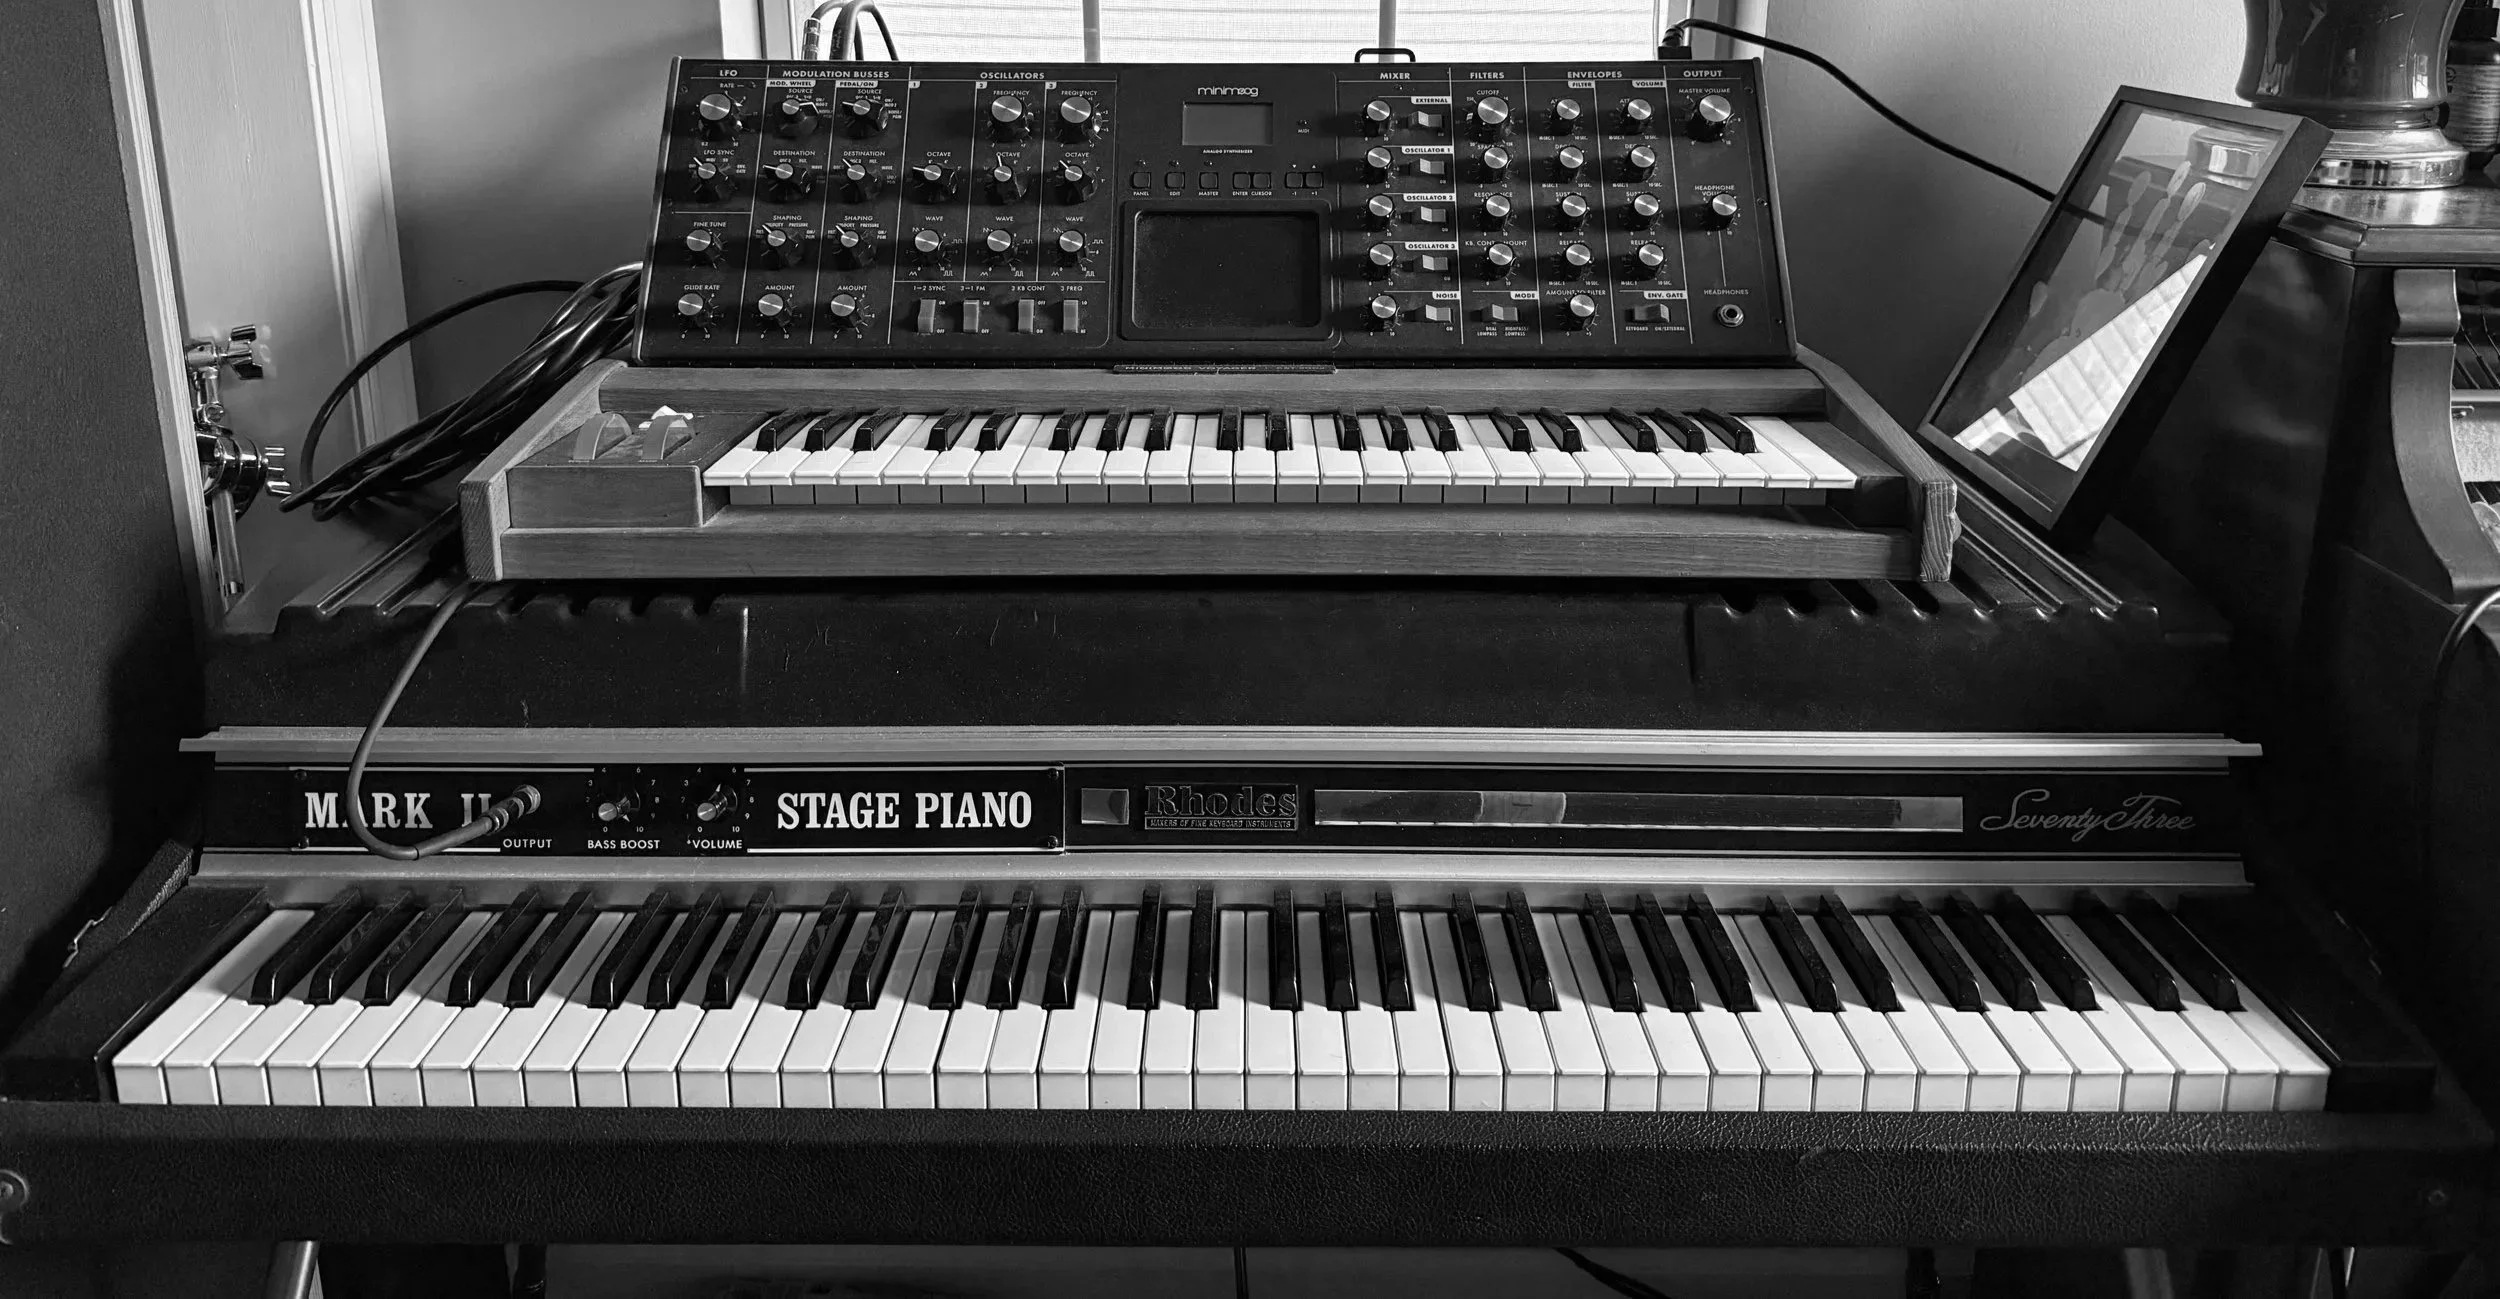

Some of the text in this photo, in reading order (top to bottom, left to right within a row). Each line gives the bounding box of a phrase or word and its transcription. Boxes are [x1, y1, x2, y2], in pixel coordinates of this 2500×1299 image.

[719, 69, 738, 77] LFO
[782, 70, 850, 78] MODULATION
[1379, 72, 1411, 80] MIXER
[1567, 71, 1623, 79] ENVELOPES
[1683, 70, 1722, 78] OUTPUT
[1197, 86, 1259, 97] minimoog
[1144, 784, 1297, 817] Rhodes
[461, 793, 493, 828] II
[777, 790, 1032, 829] STAGE PIANO
[1980, 788, 2197, 842] Seventy Three
[1150, 819, 1178, 827] MAKERS
[1209, 820, 1244, 828] KEYBOARD
[1245, 820, 1292, 828] INSTRUMENTS
[502, 838, 553, 849] OUTPUT
[587, 839, 661, 849] BASS BOOST
[692, 839, 743, 849] VOLUME
